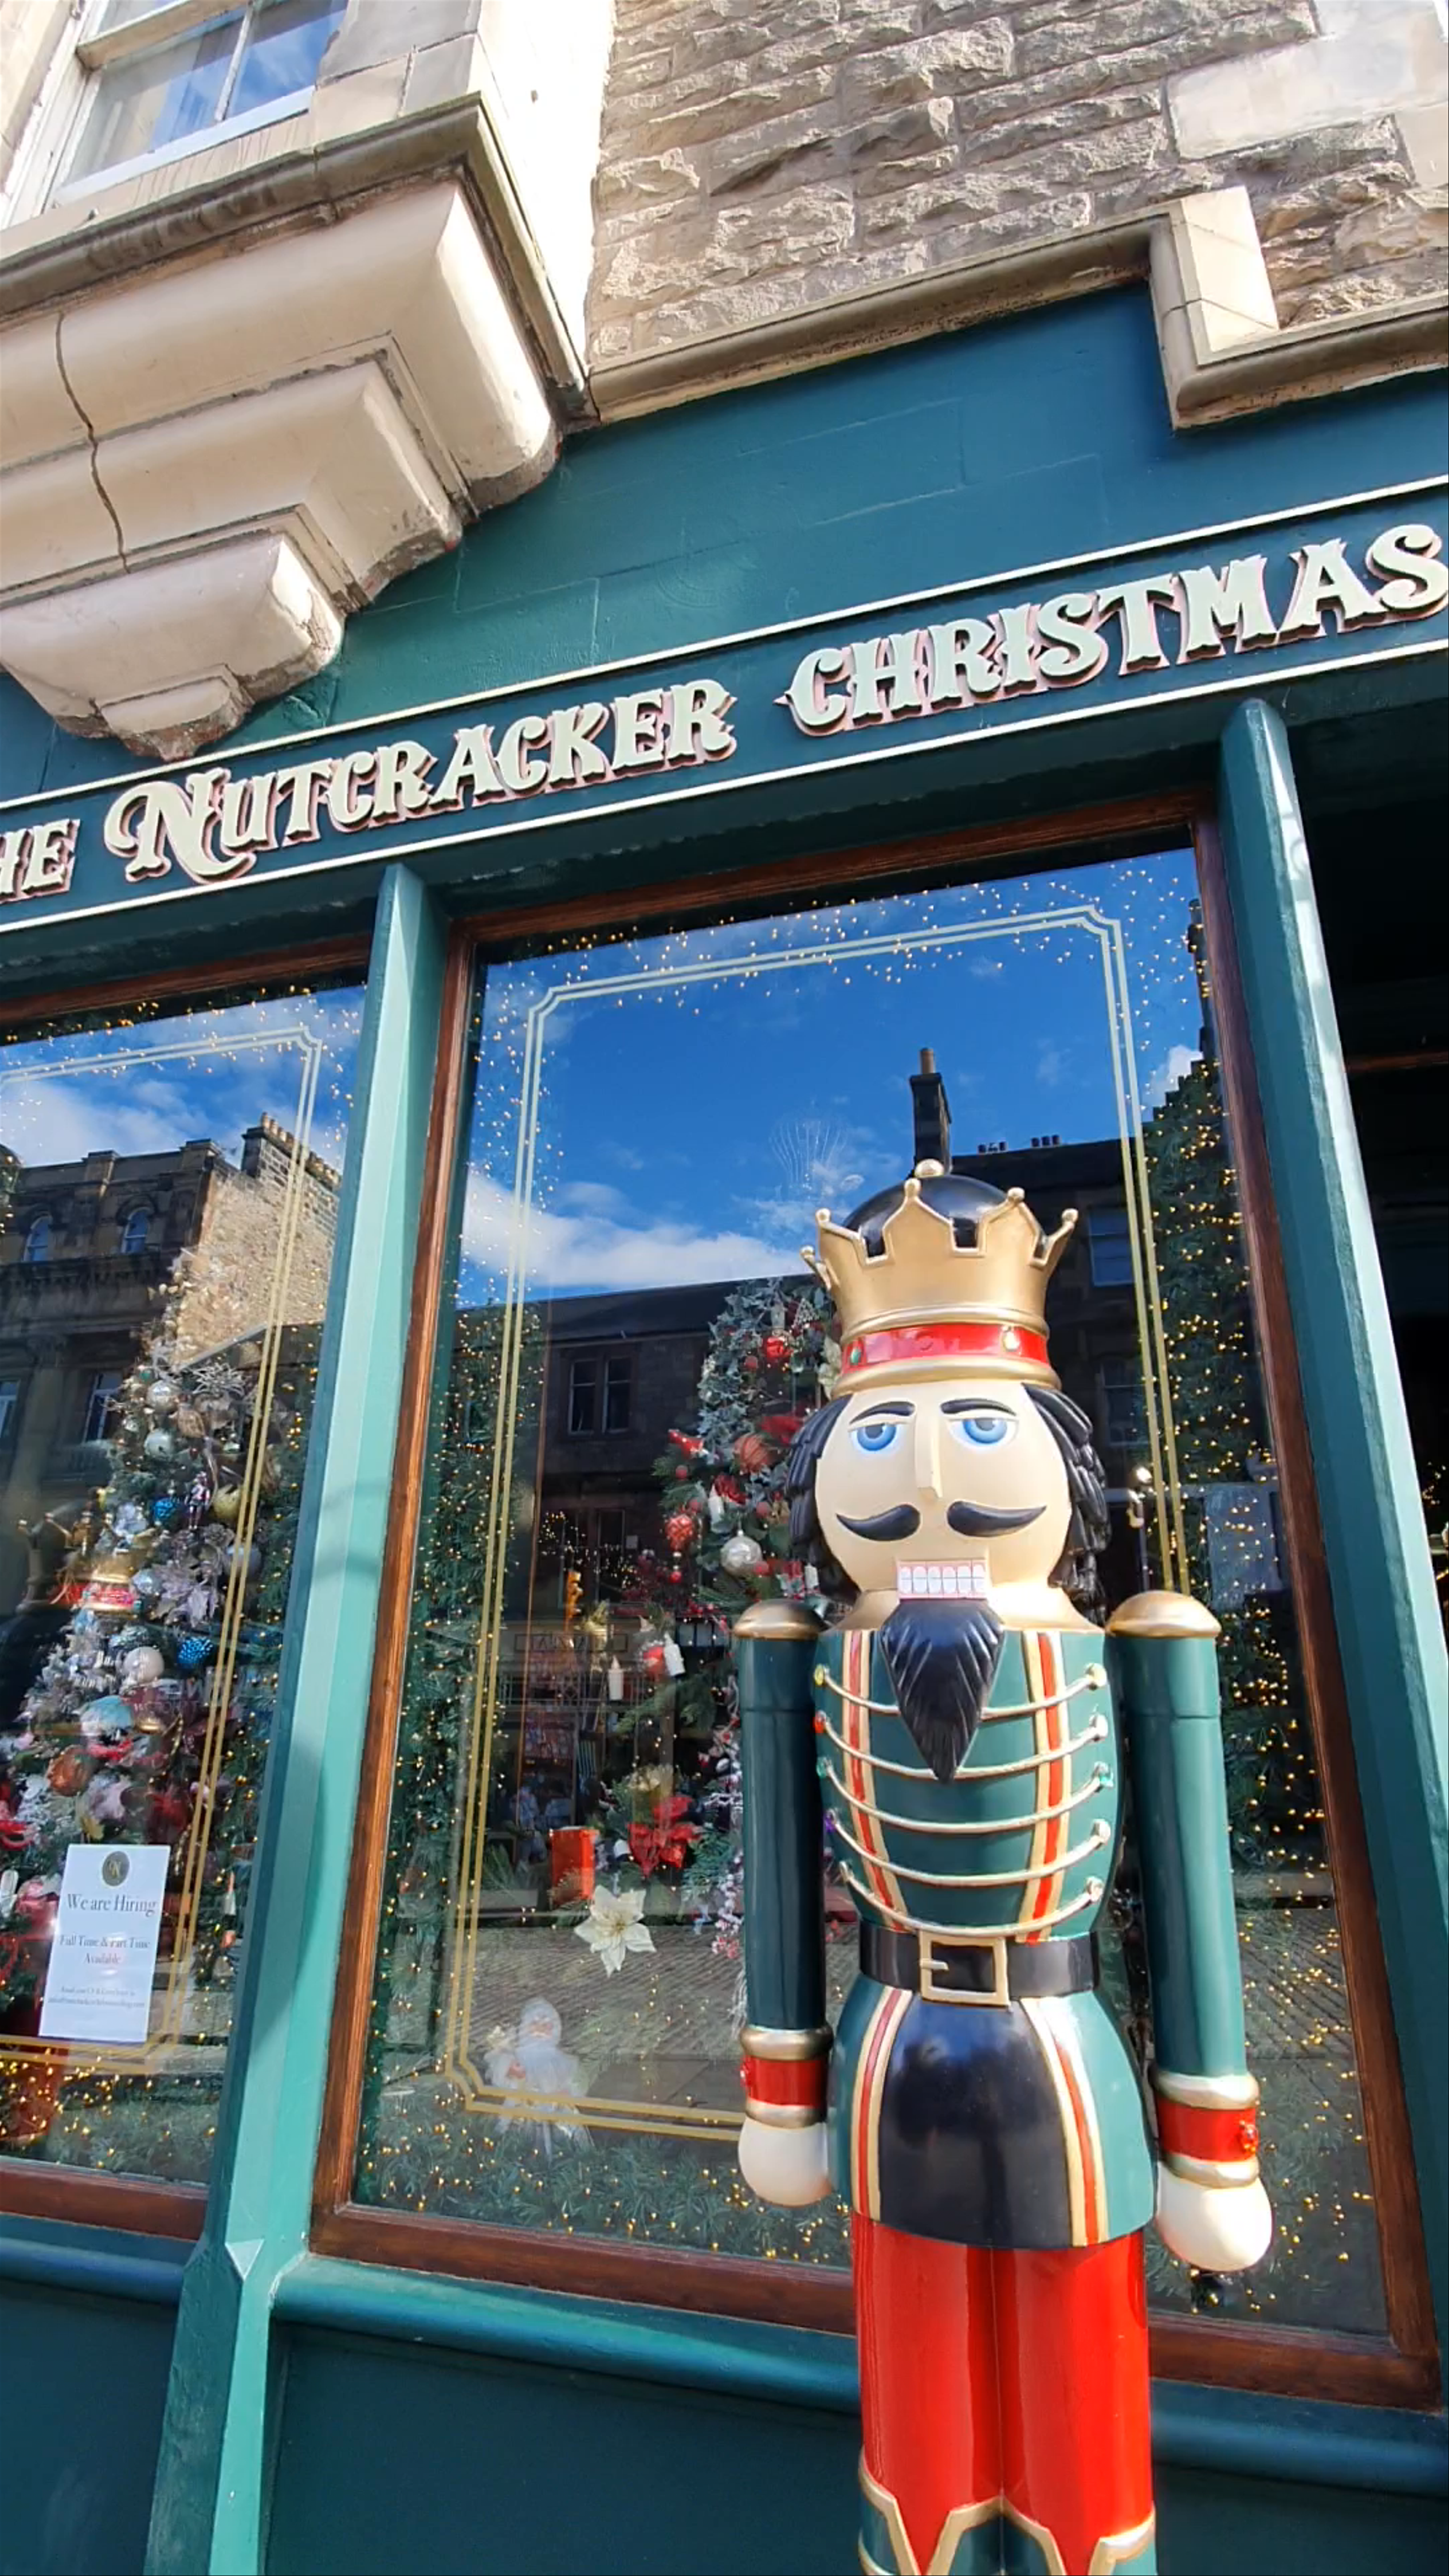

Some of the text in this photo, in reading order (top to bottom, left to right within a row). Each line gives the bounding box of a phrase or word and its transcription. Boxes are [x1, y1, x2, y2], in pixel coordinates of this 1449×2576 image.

[105, 679, 738, 884] NUTCRACKER
[774, 524, 1449, 737] CHRISTMAS
[68, 1893, 156, 1917] We are Hiring
[60, 1934, 77, 1946] Full
[78, 1935, 100, 1947] Time
[100, 1937, 108, 1947] &
[128, 1937, 150, 1949] Time
